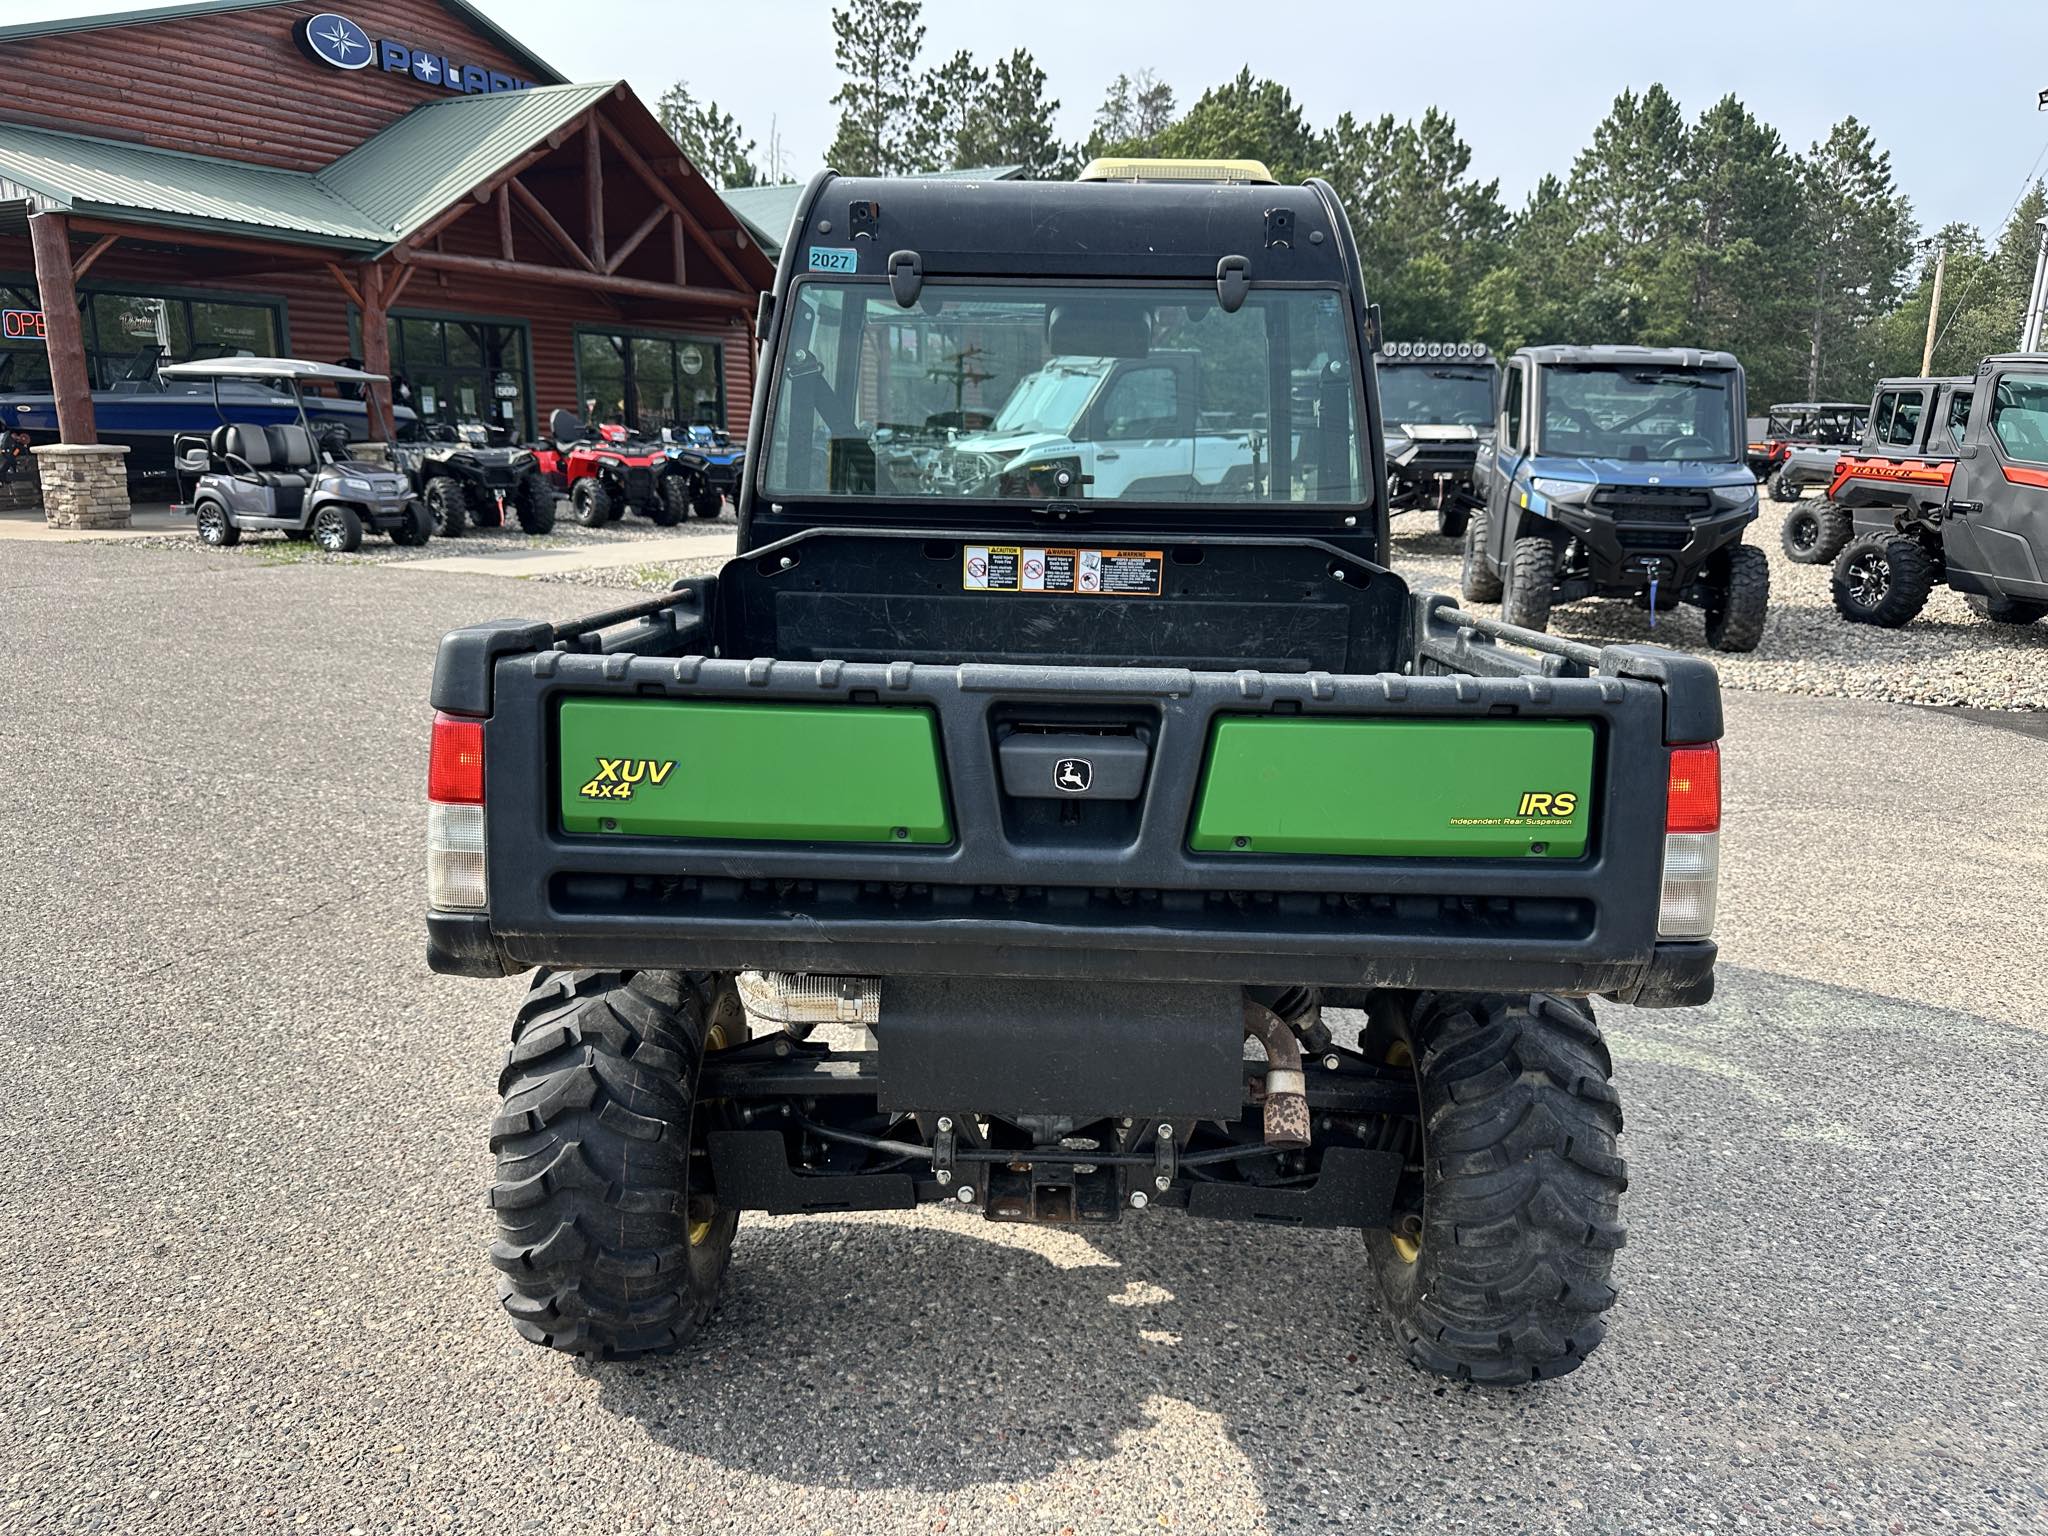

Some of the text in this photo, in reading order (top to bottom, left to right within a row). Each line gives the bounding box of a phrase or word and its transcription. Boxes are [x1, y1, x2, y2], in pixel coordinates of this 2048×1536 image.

[378, 39, 540, 95] POLAR
[811, 253, 849, 269] 2027
[6, 312, 46, 337] OPE
[1856, 467, 1912, 477] RANGER
[594, 758, 675, 784] XUV
[580, 780, 632, 799] 4x4
[1518, 792, 1577, 816] IRS
[1450, 818, 1501, 826] Independent
[1525, 818, 1572, 826] Suspension
